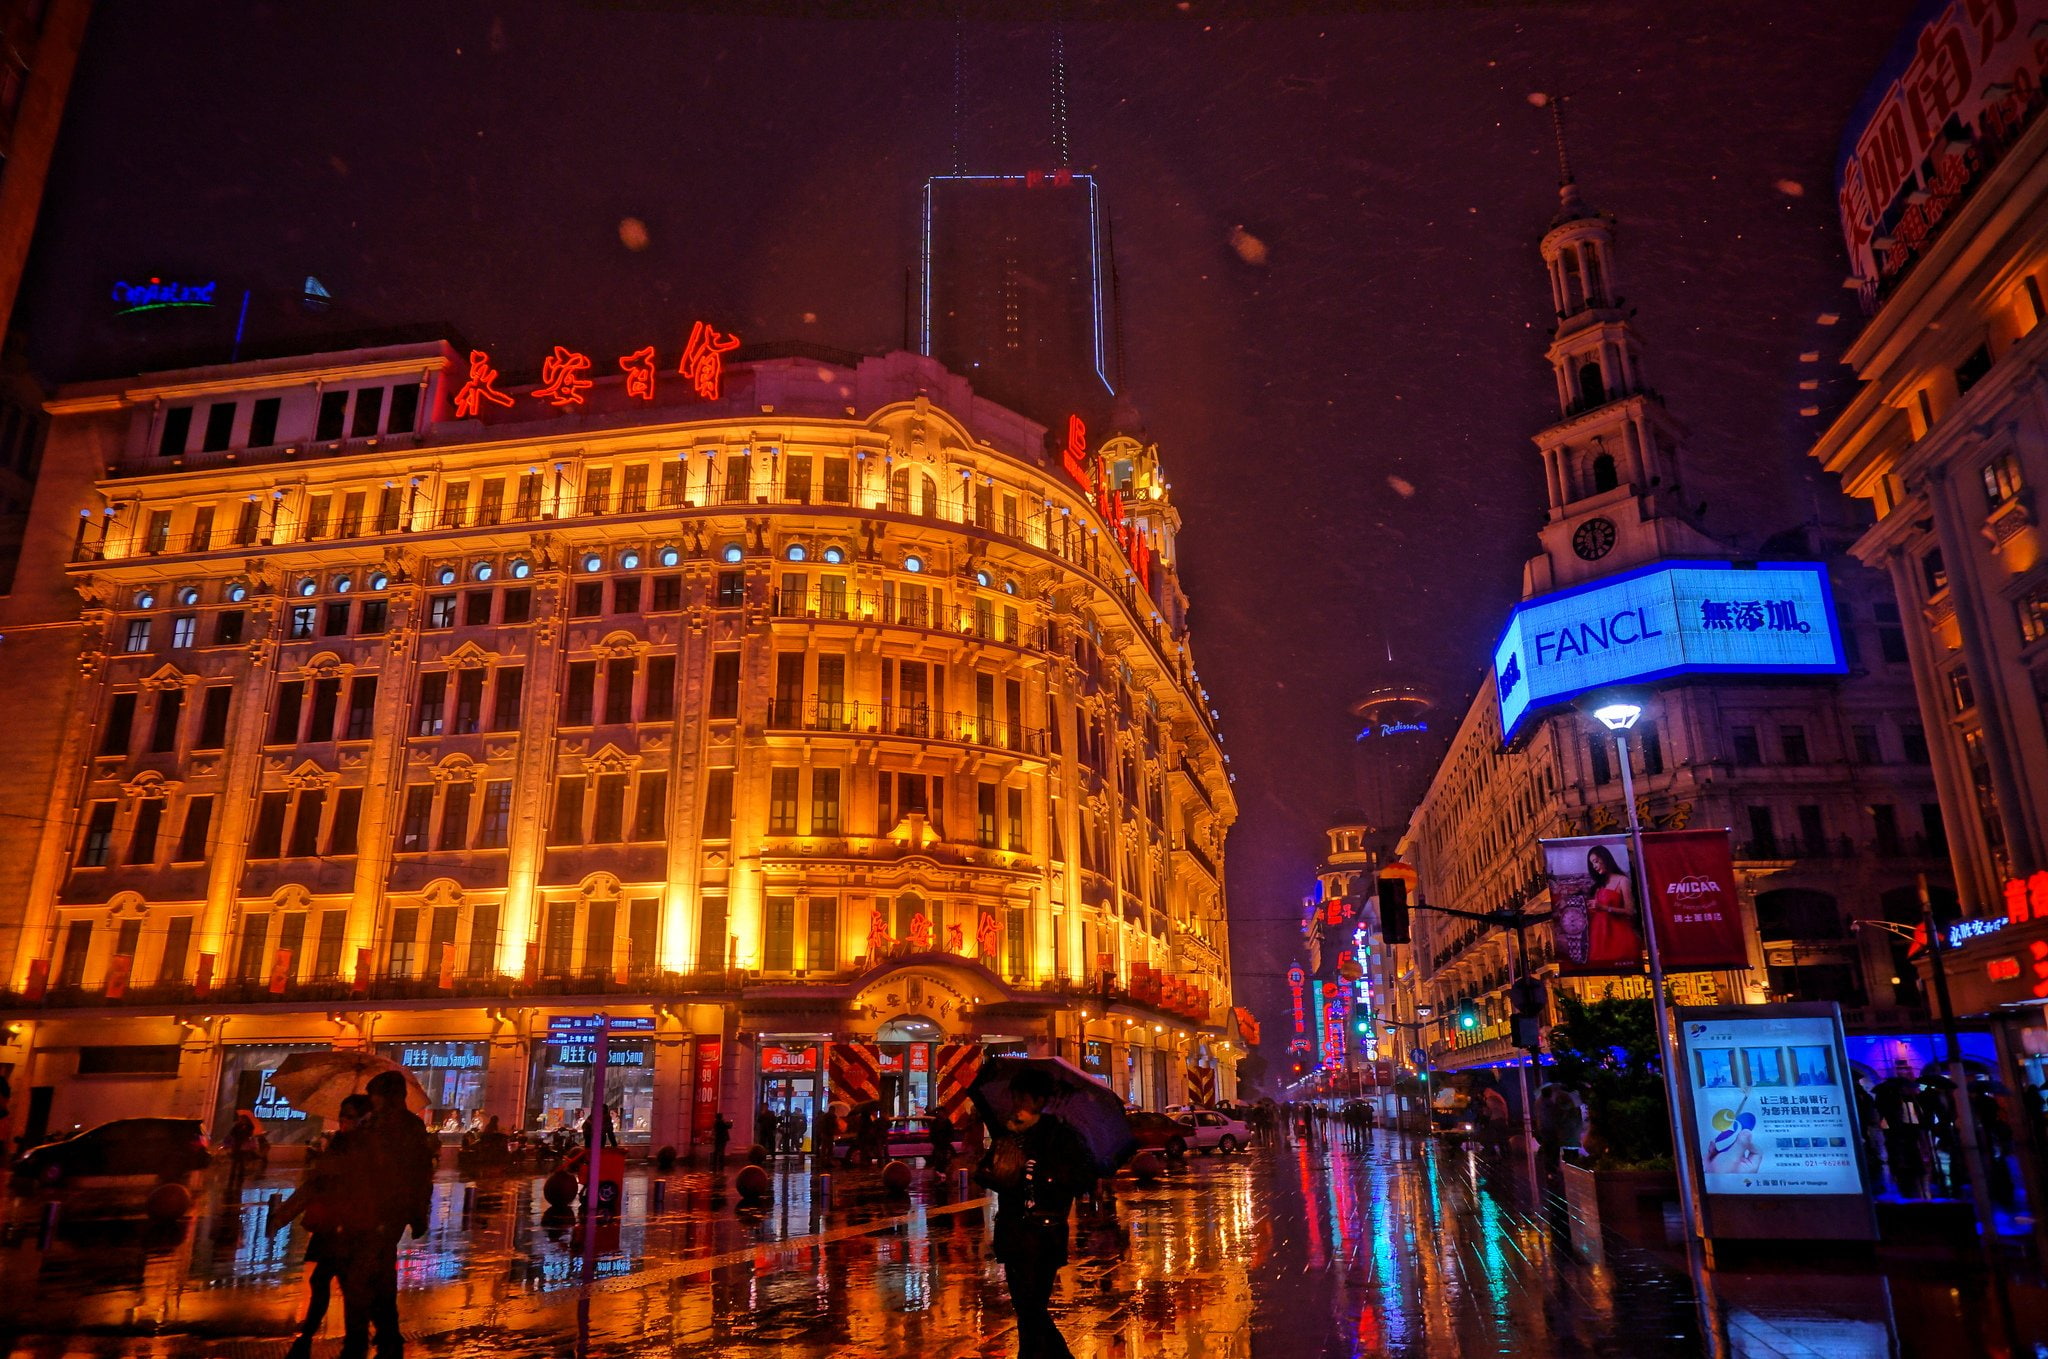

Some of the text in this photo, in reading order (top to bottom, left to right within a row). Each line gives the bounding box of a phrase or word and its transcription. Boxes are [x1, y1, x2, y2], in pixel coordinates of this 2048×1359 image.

[1535, 607, 1662, 665] FANCL
[1380, 721, 1419, 737] Radisson
[1667, 881, 1721, 894] ENICAR
[402, 1049, 429, 1066] 周生生
[430, 1054, 449, 1067] Chow
[449, 1053, 466, 1069] Sang
[559, 1045, 586, 1063] 周生生
[608, 1050, 626, 1066] Sang
[626, 1050, 644, 1066] Sang
[701, 1068, 712, 1083] 99
[1760, 1095, 1829, 1105] 让三地上海银行
[1761, 1106, 1841, 1116] 为您开启财富之门
